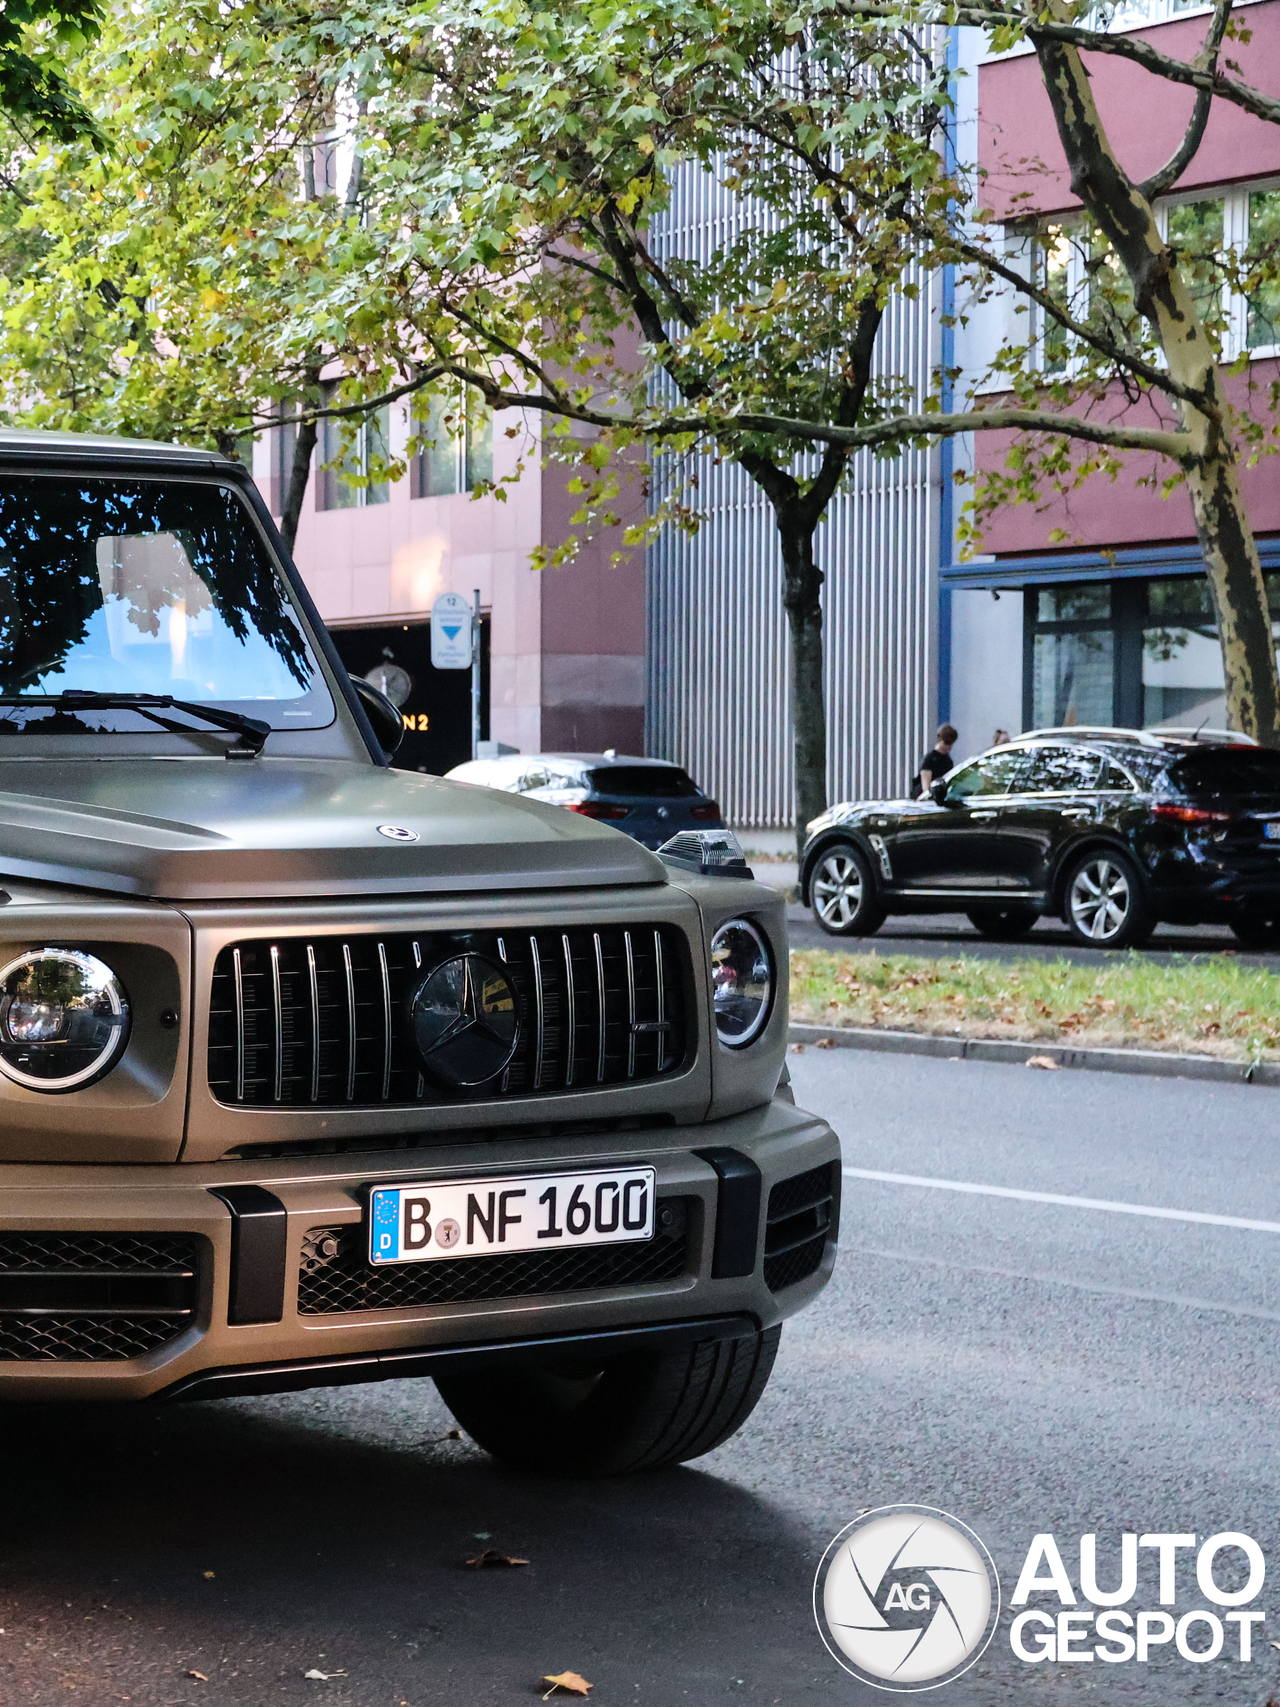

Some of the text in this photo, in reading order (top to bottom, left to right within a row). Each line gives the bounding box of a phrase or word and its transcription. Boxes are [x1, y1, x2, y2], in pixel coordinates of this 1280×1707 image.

[404, 1178, 648, 1249] B NF 1600
[380, 1233, 392, 1249] D
